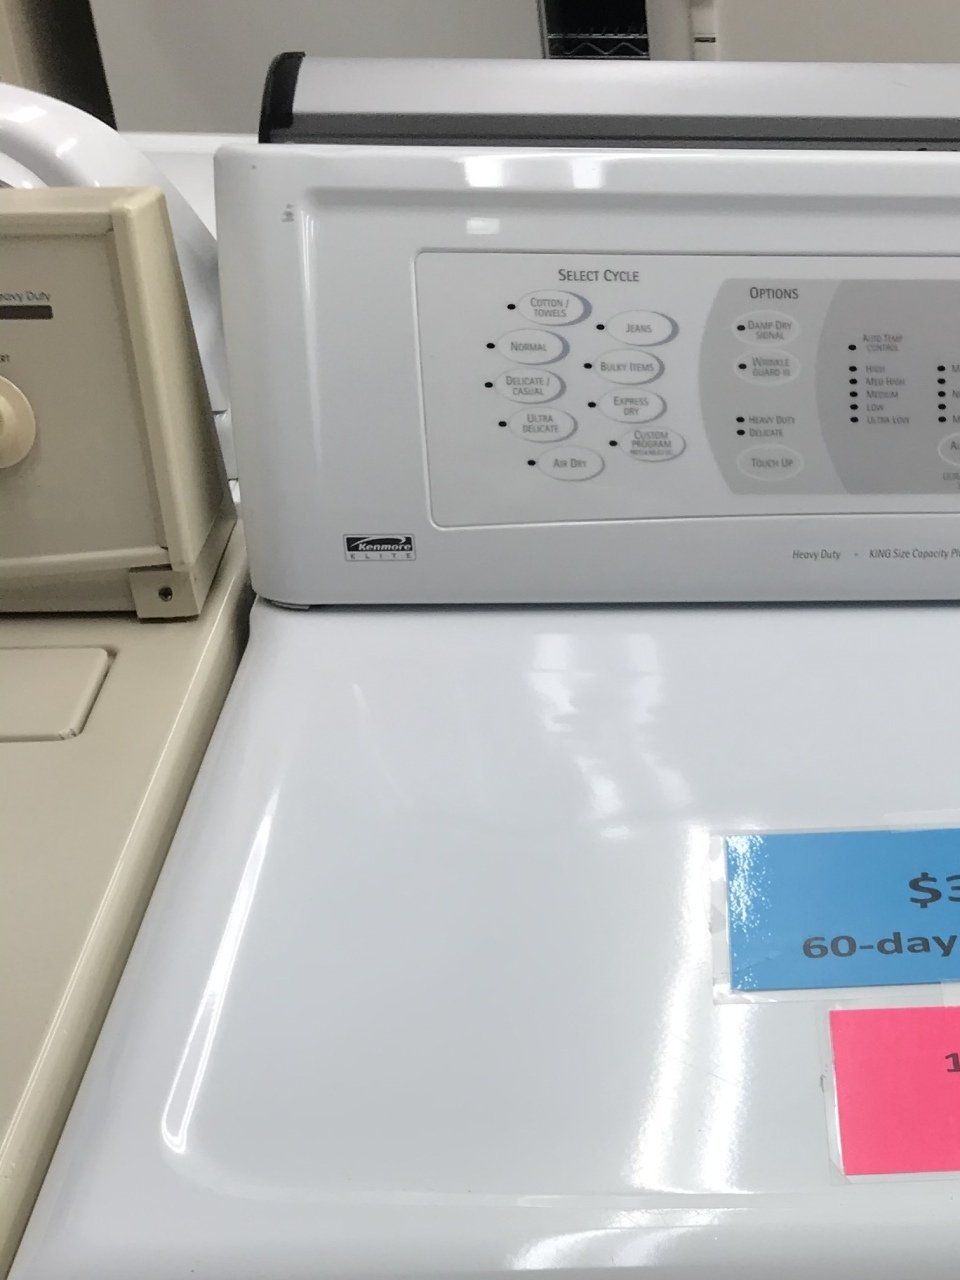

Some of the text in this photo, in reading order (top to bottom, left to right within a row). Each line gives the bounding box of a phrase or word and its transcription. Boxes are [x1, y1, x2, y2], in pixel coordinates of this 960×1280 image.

[558, 269, 640, 282] SELECT CYCLE
[750, 287, 799, 299] OPTIONS
[534, 309, 567, 318] TOWELS
[626, 323, 653, 333] JEANS
[510, 342, 548, 352] NORMAL
[600, 362, 655, 372] BULKY ITEMS
[506, 376, 544, 386] DELICATE
[513, 387, 544, 395] CASUAL
[613, 396, 649, 406] EXPRESS
[527, 414, 554, 423] ULTRA
[522, 424, 559, 433] DELICATE
[553, 458, 587, 468] AIR DRY
[751, 458, 779, 468] TOUCH
[358, 543, 412, 551] Kenmore
[792, 549, 841, 561] Heavy Duty
[869, 549, 892, 559] KING
[893, 549, 910, 558] Size
[912, 548, 949, 560] Capacity
[801, 930, 959, 959] 60-day
